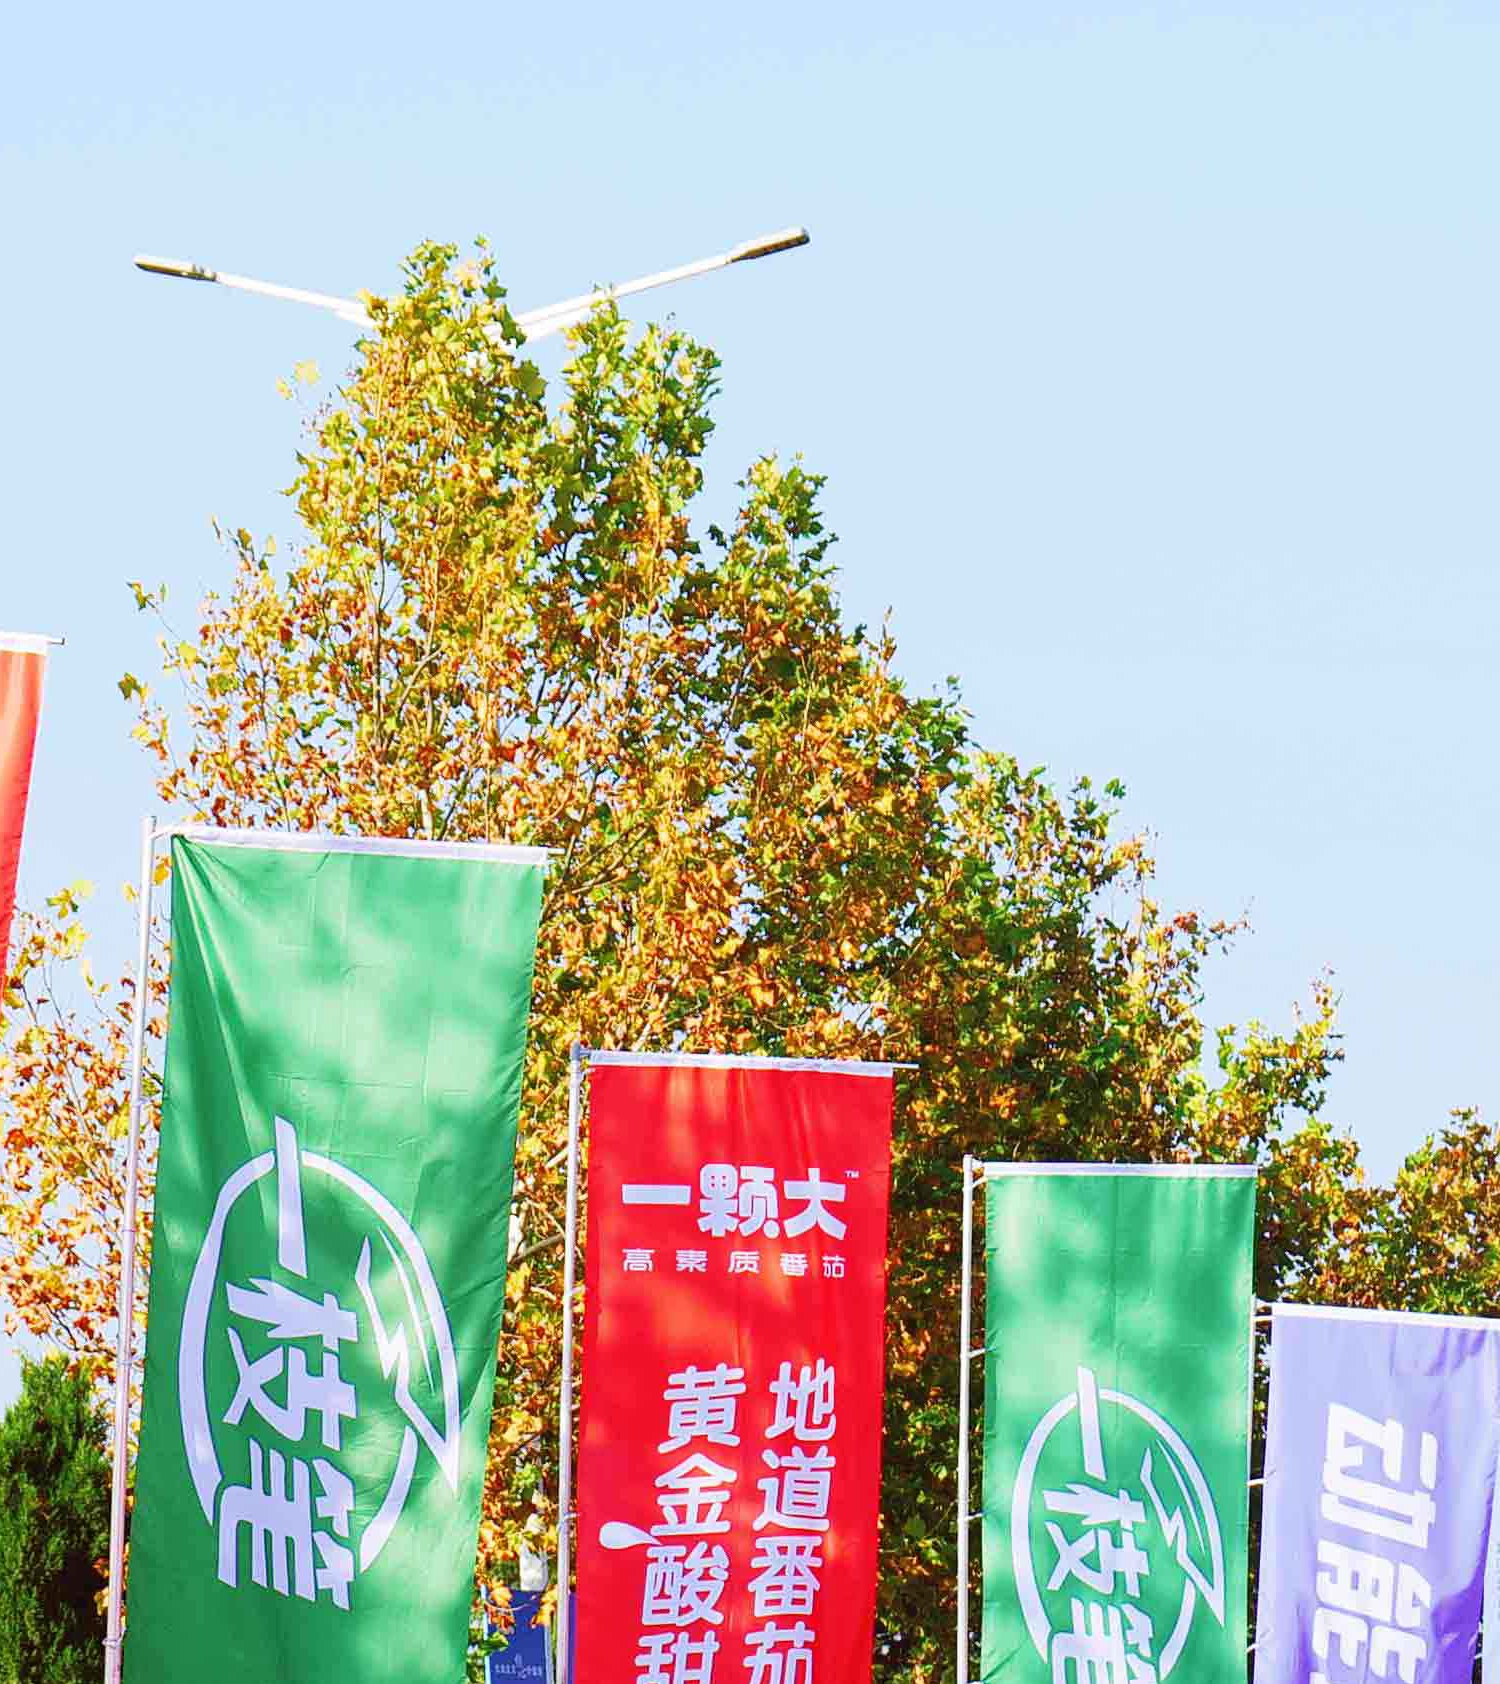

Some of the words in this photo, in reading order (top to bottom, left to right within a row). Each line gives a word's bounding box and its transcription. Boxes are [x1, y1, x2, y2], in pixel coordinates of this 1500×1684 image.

[622, 1248, 845, 1278] 高素质番茄
